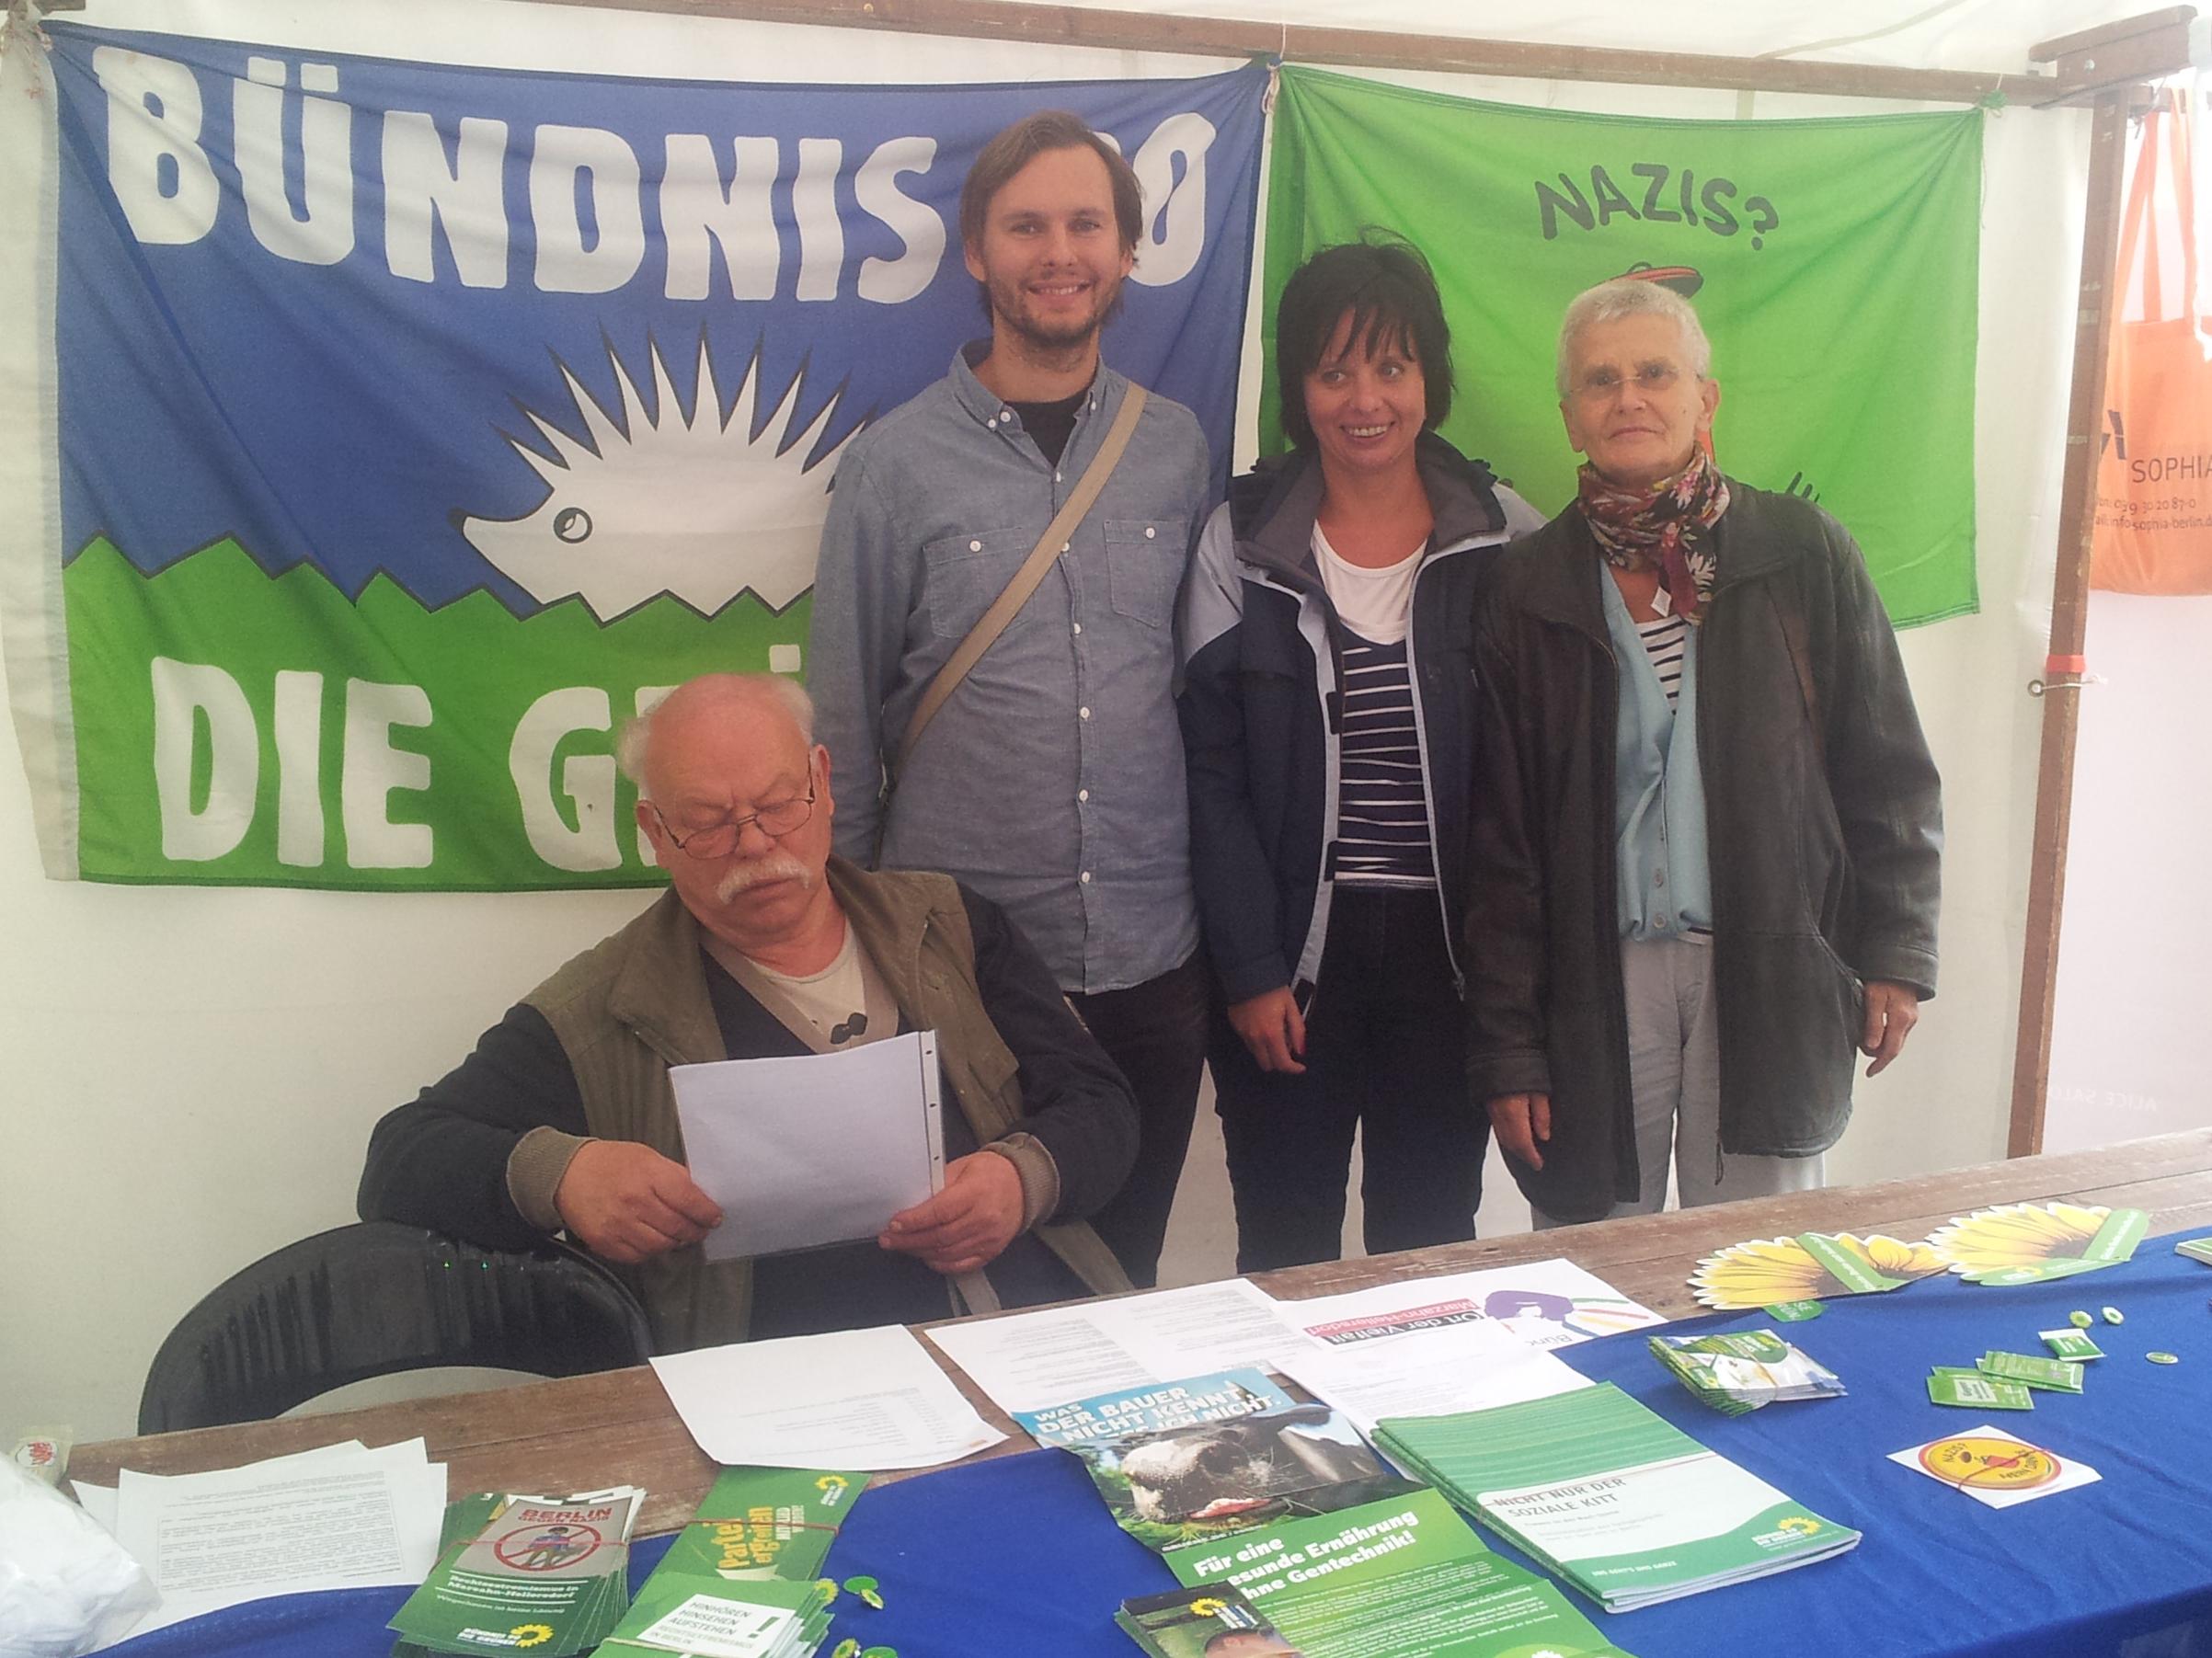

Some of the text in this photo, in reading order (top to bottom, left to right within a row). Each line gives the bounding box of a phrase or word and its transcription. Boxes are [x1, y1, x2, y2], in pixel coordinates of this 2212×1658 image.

[93, 46, 1216, 303] BÜNDNIS 0
[1535, 162, 1779, 250] NAZIS?
[151, 656, 433, 869] DIE
[1034, 1402, 1082, 1423] WAS
[1037, 1411, 1095, 1434] DER
[1097, 1387, 1190, 1418] BAUER
[1060, 1412, 1147, 1442] NICHT
[521, 1506, 613, 1521] BERLIN
[1493, 1479, 1627, 1507] NICHT NUR DER
[1507, 1493, 1619, 1518] SOZIALE KITT
[1193, 1554, 1233, 1578] Für
[1236, 1537, 1285, 1563] eine
[1227, 1550, 1306, 1587] esunde
[1304, 1510, 1420, 1560] Ernährung
[1241, 1577, 1287, 1601] hne
[1287, 1529, 1417, 1584] Gentechnik!
